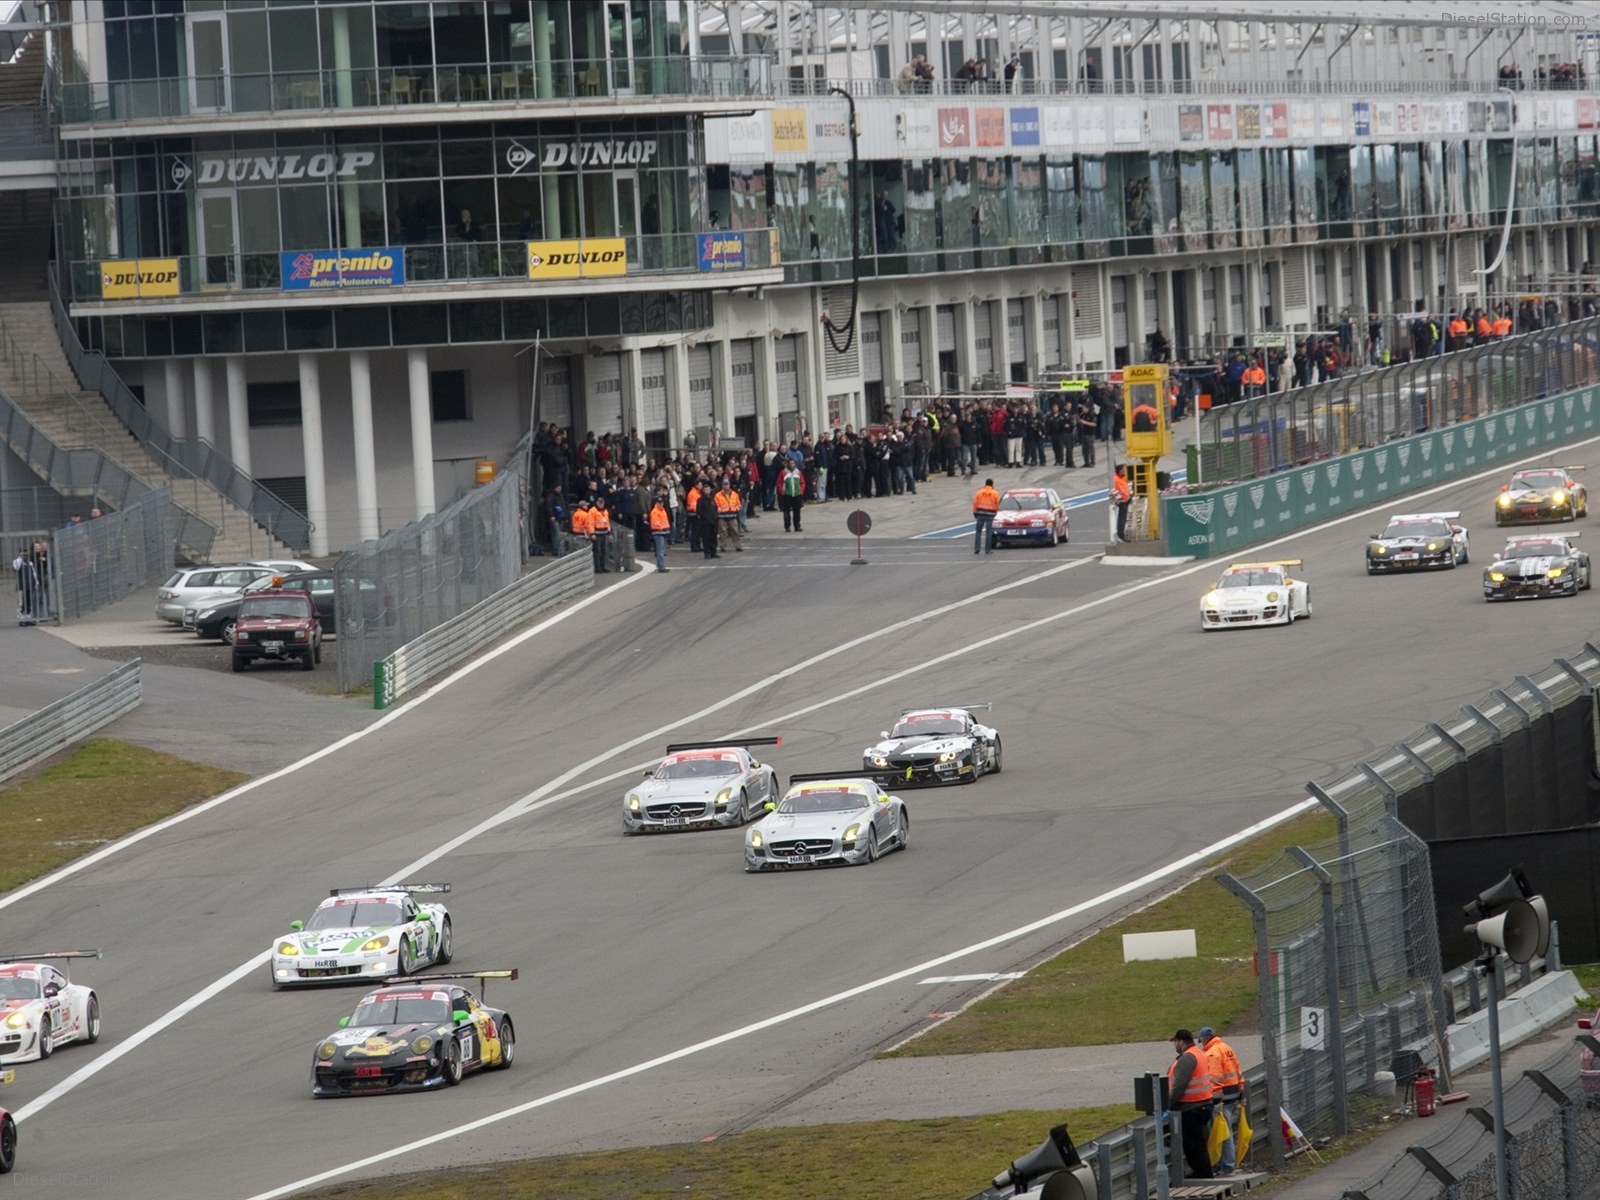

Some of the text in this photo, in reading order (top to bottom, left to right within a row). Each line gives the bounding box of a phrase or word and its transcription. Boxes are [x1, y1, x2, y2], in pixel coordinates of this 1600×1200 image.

[542, 140, 657, 167] DUNLOP
[197, 152, 375, 183] DUNLOP
[546, 251, 624, 265] DUNLOP
[712, 235, 742, 259] premio
[312, 251, 393, 277] premio
[114, 272, 177, 285] DUNLOP
[1188, 535, 1207, 545] ASTON
[1308, 1011, 1319, 1037] 3
[463, 1039, 470, 1059] 88
